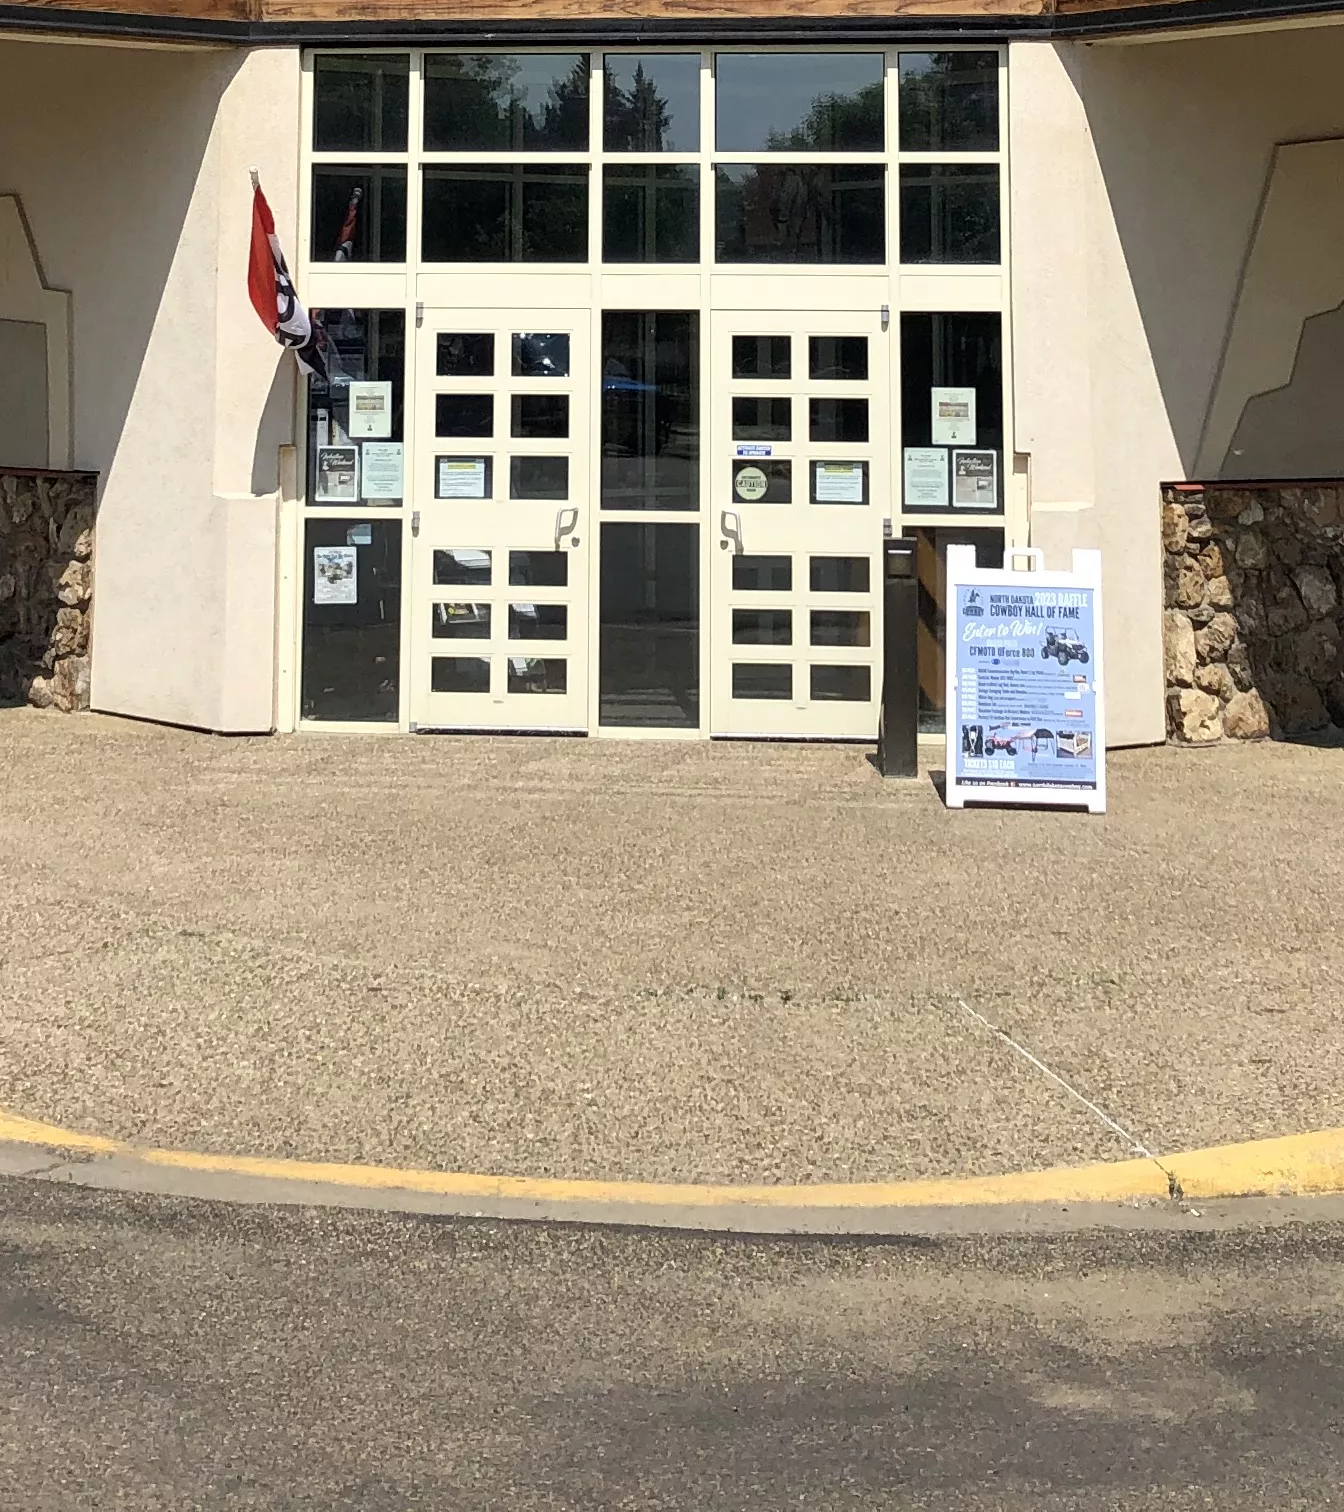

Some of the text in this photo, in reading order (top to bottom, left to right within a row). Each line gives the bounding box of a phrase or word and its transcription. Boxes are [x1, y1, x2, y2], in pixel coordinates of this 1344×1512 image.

[990, 604, 1080, 619] COWBOY HALL OF FAME
